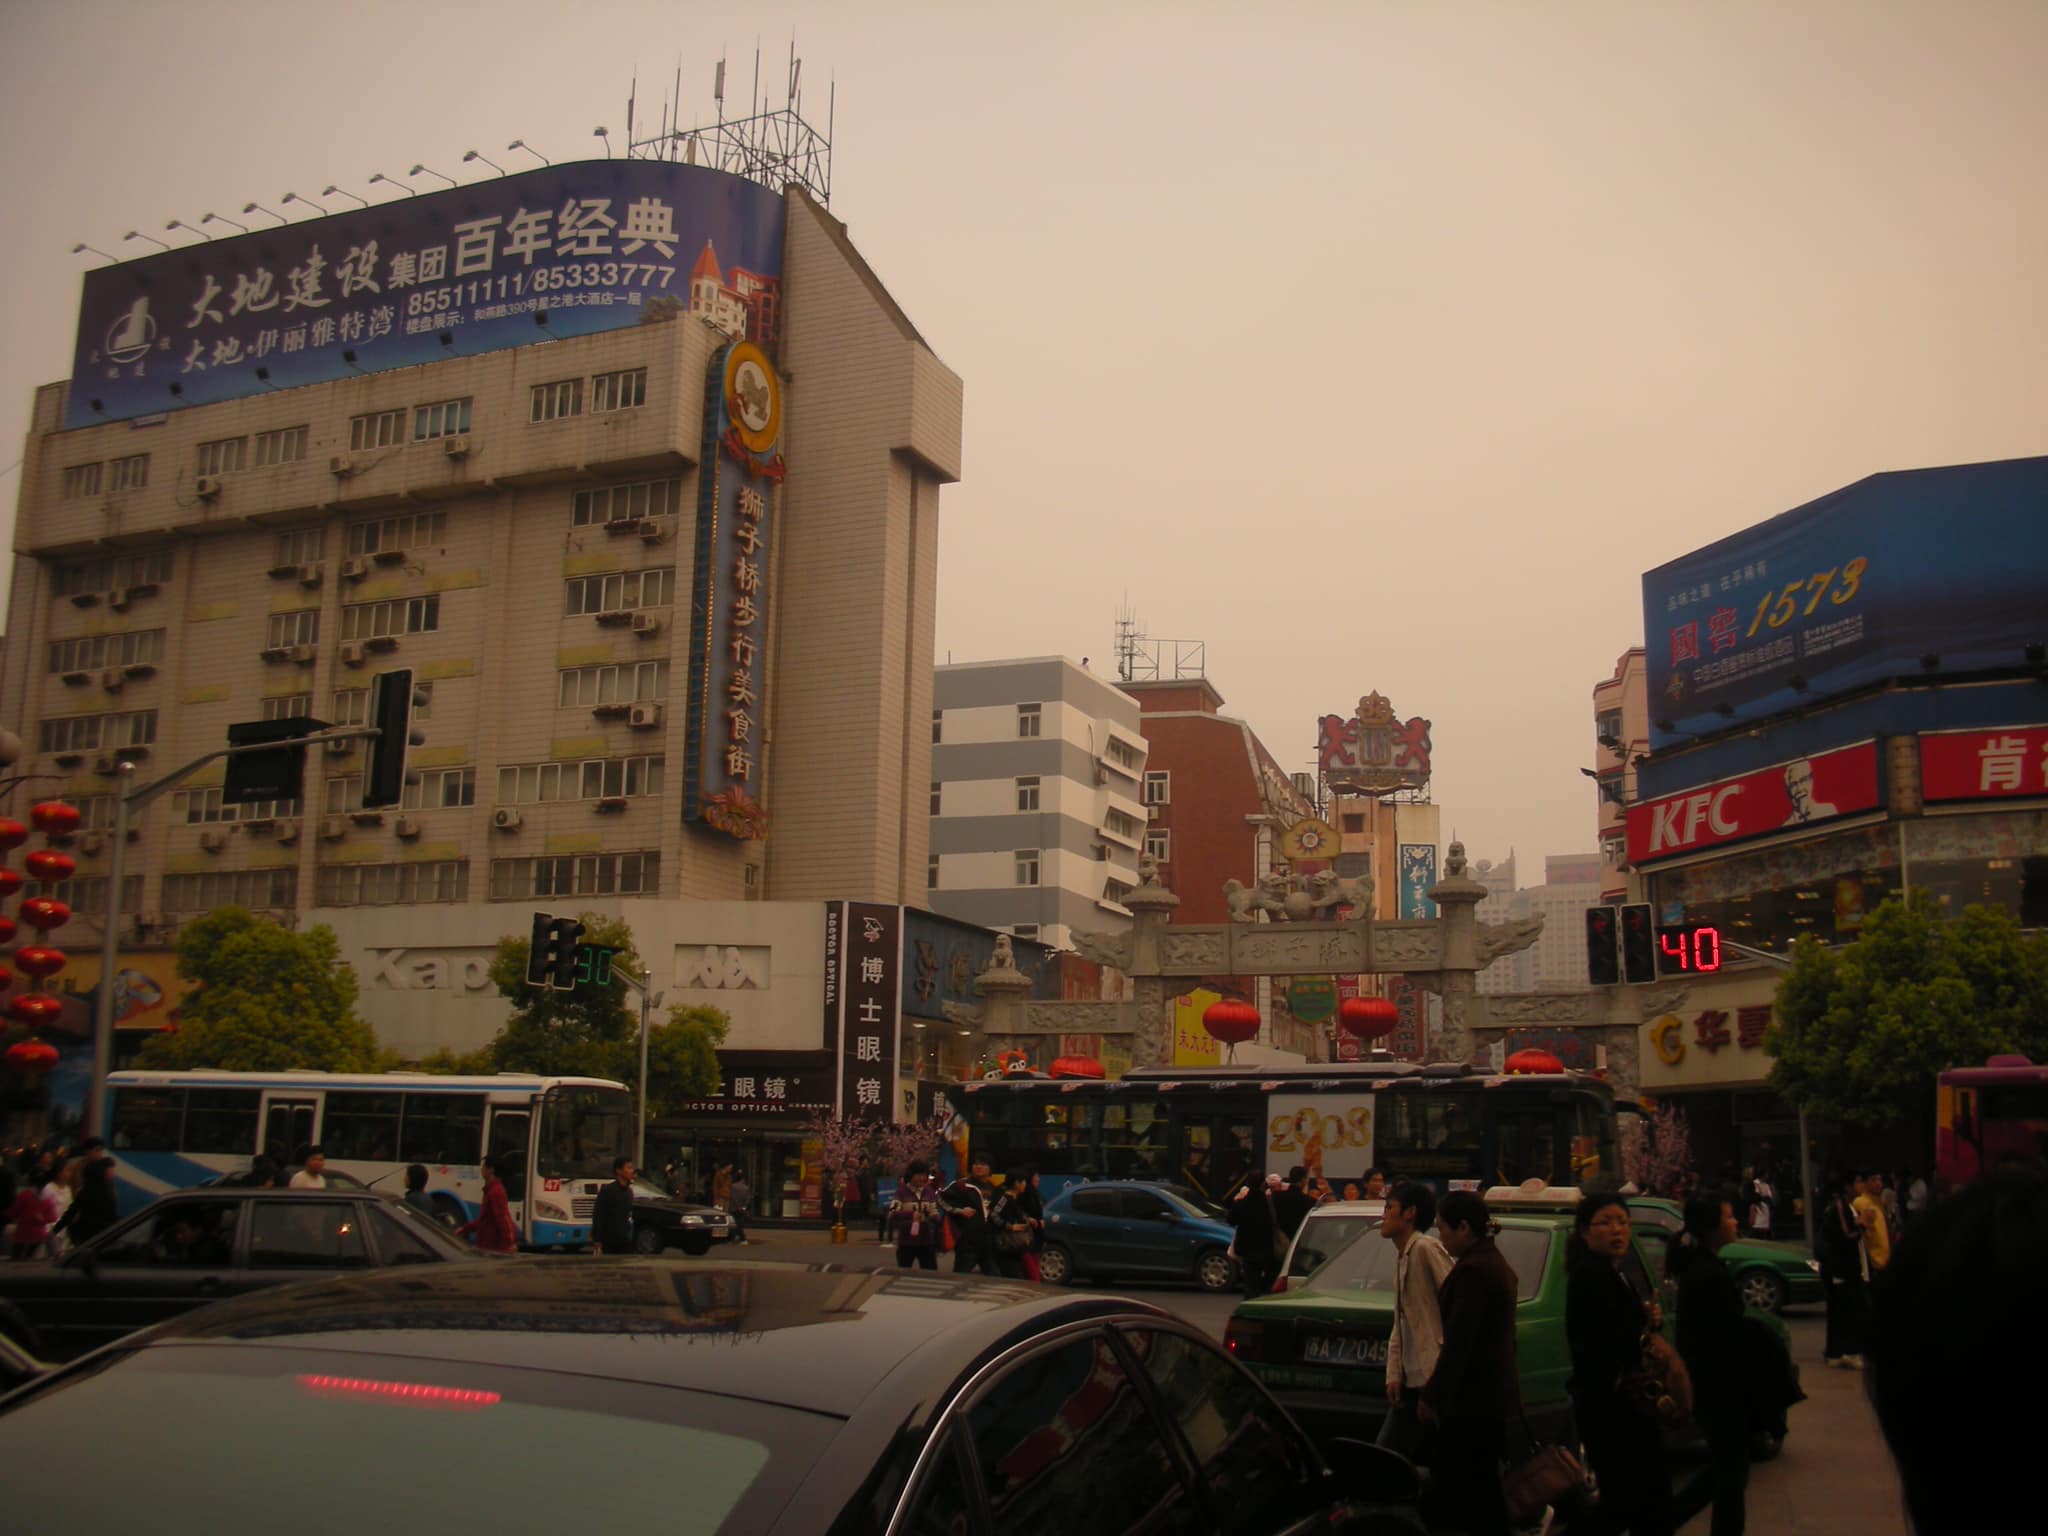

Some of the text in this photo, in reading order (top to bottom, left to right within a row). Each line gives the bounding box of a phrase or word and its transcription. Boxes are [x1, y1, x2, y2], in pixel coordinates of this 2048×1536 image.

[454, 198, 679, 277] 百年经典
[1746, 556, 1868, 638] 1573
[1978, 735, 2048, 791] 肯
[1649, 783, 1744, 852] KFC
[374, 949, 493, 997] Kap
[577, 947, 613, 985] 30
[826, 912, 838, 1005] DOCTOR OPTICAL
[1660, 926, 1721, 972] 40
[856, 956, 885, 1105] 博士眼镜
[686, 1103, 724, 1111] CTOR
[731, 1103, 786, 1112] OPTICAL
[1270, 1107, 1372, 1152] 2008
[544, 1178, 560, 1192] 47
